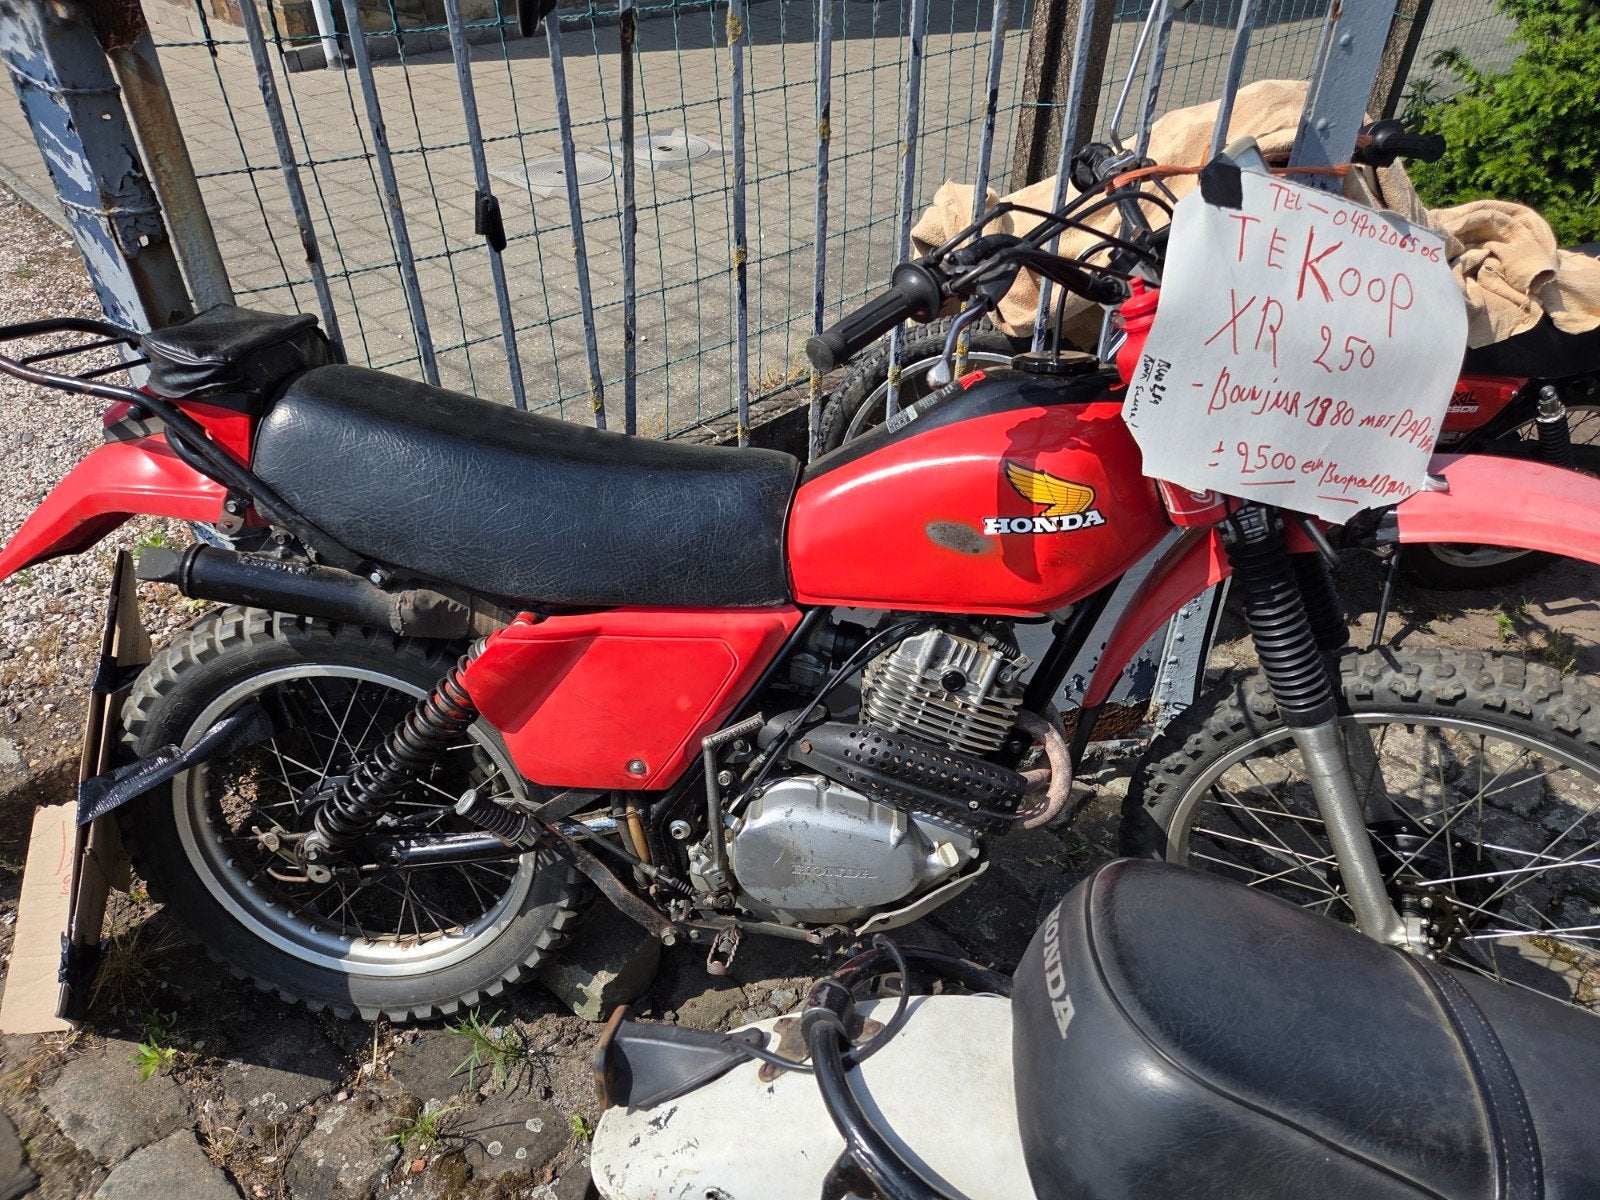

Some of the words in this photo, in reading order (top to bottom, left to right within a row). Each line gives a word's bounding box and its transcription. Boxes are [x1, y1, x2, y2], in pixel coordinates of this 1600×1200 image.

[1229, 214, 1287, 269] TE
[1204, 288, 1284, 368] XR
[1312, 325, 1375, 373] 250
[1237, 441, 1296, 473] 2500
[984, 509, 1106, 535] HONDA
[791, 864, 877, 879] HONDA
[1043, 901, 1075, 1040] HONDA
